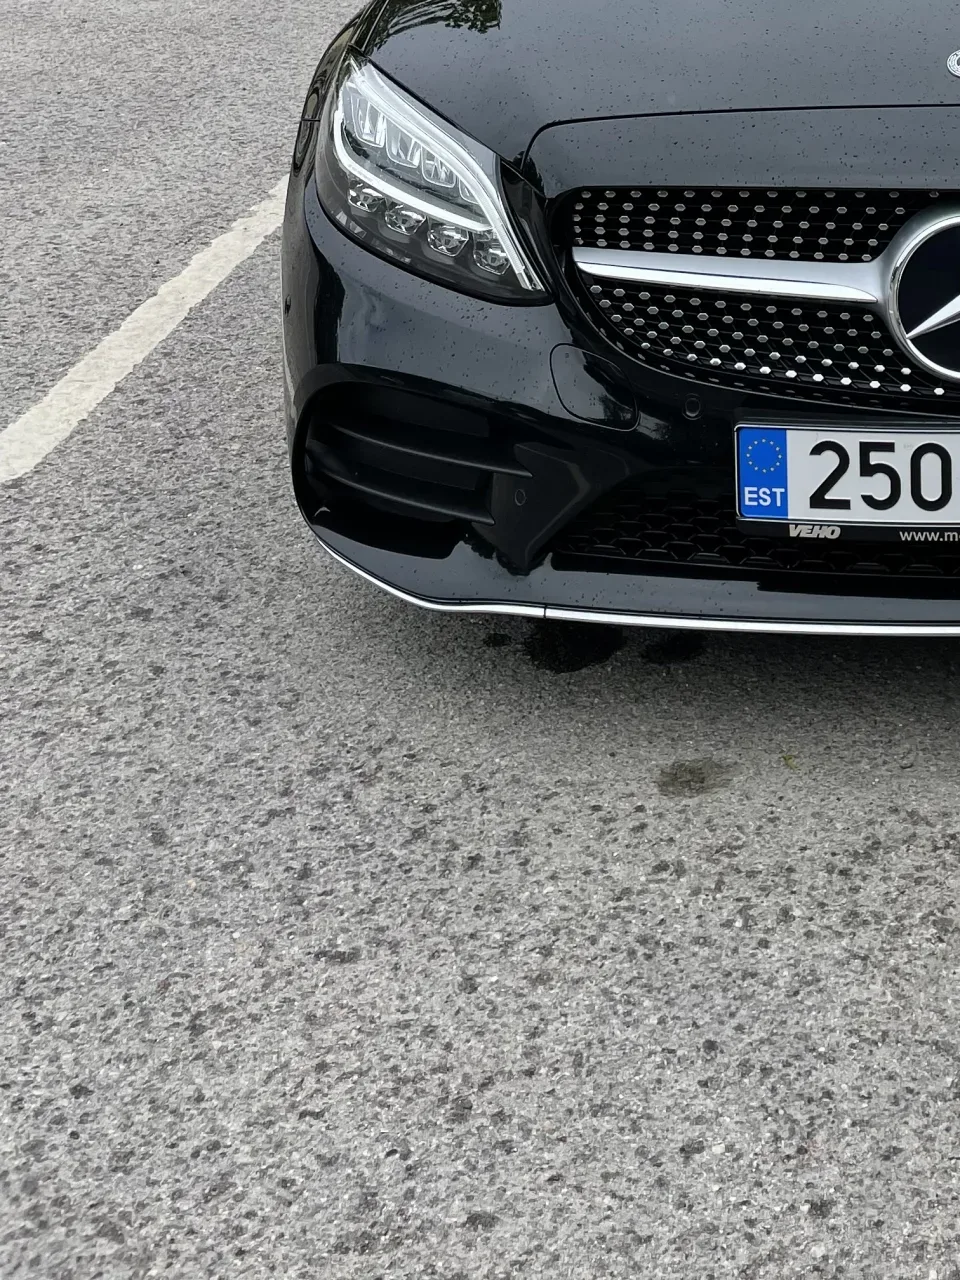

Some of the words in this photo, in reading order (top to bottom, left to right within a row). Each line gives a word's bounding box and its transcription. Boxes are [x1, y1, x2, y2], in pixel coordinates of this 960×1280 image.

[809, 440, 953, 512] 250
[744, 487, 785, 507] EST
[789, 524, 841, 539] VEHO
